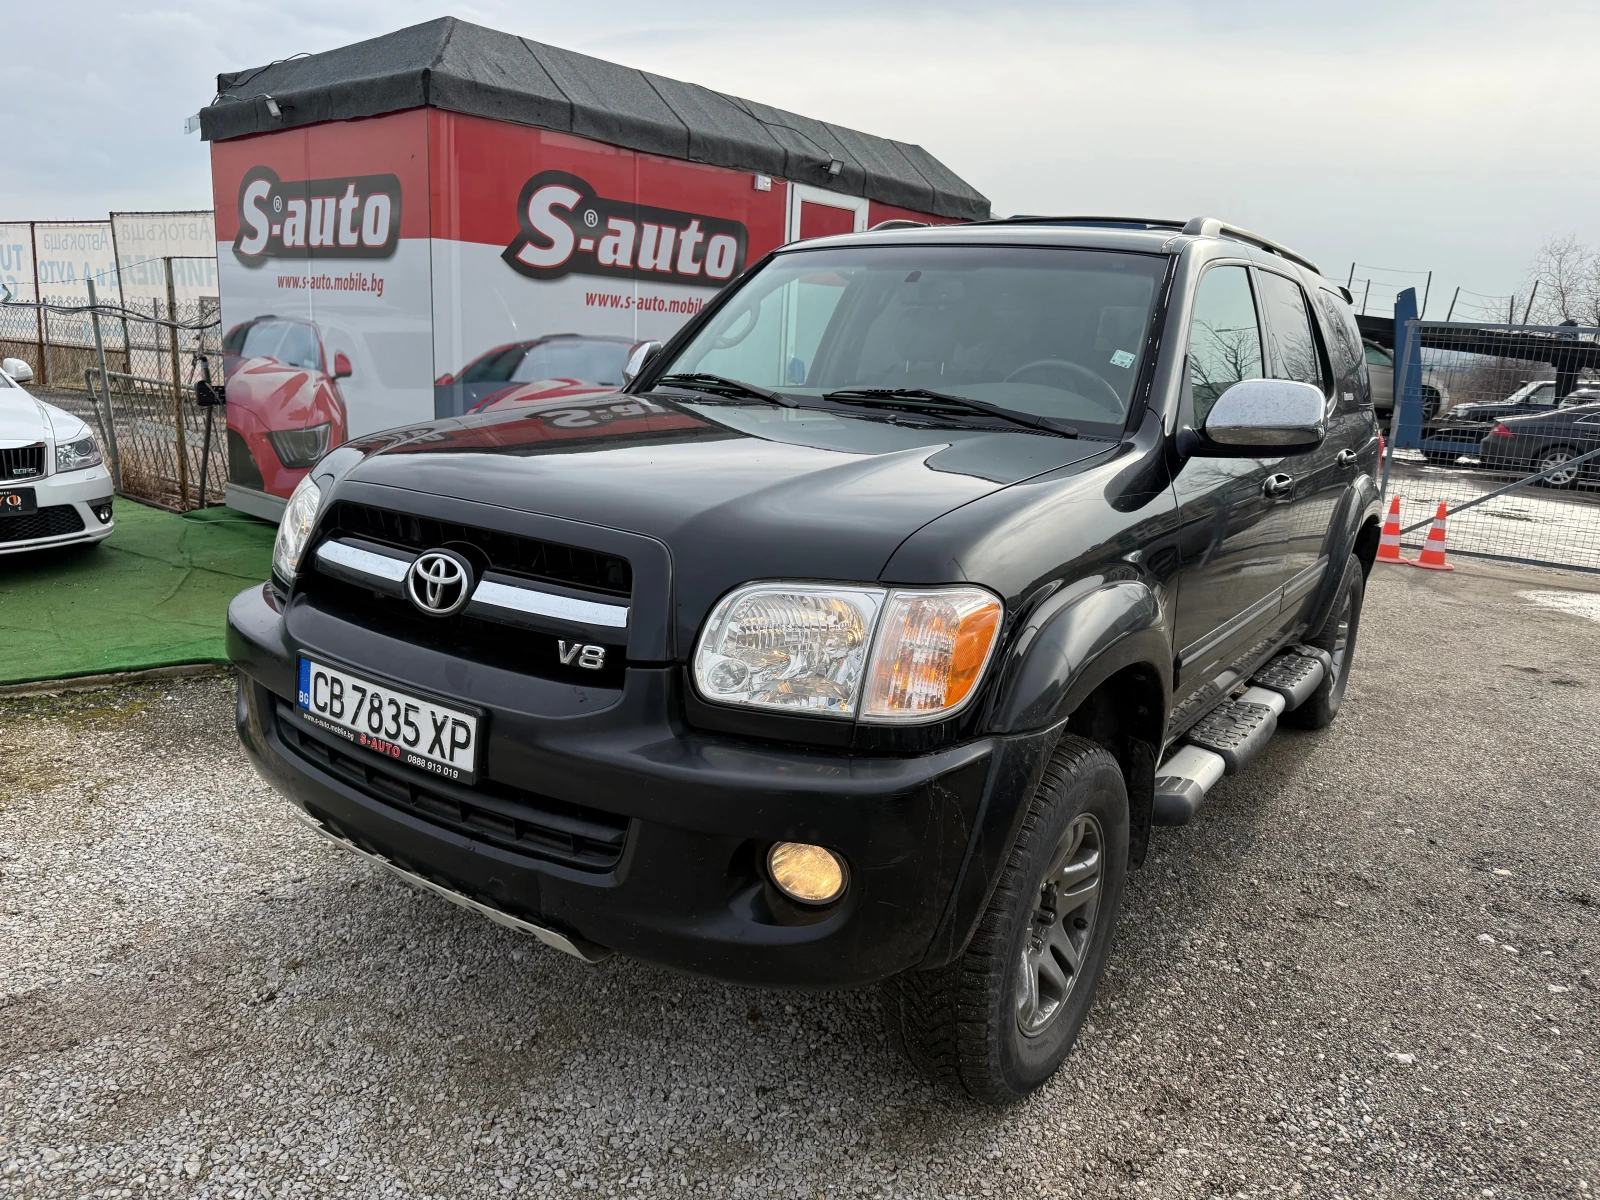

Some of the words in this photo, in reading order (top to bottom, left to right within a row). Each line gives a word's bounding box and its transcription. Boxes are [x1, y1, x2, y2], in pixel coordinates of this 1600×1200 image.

[277, 272, 384, 297] www.s-auto.mobile.bg
[585, 292, 708, 315] www.s-auto.mobil
[558, 640, 605, 669] V8
[298, 690, 309, 705] BG
[303, 712, 355, 741] www.s-auto.mobile.bg
[313, 671, 345, 719] CB
[350, 684, 421, 747] 7835
[427, 710, 472, 762] XP
[359, 733, 401, 758] S-AUTO
[427, 761, 442, 774] 913
[443, 766, 459, 779] 019
